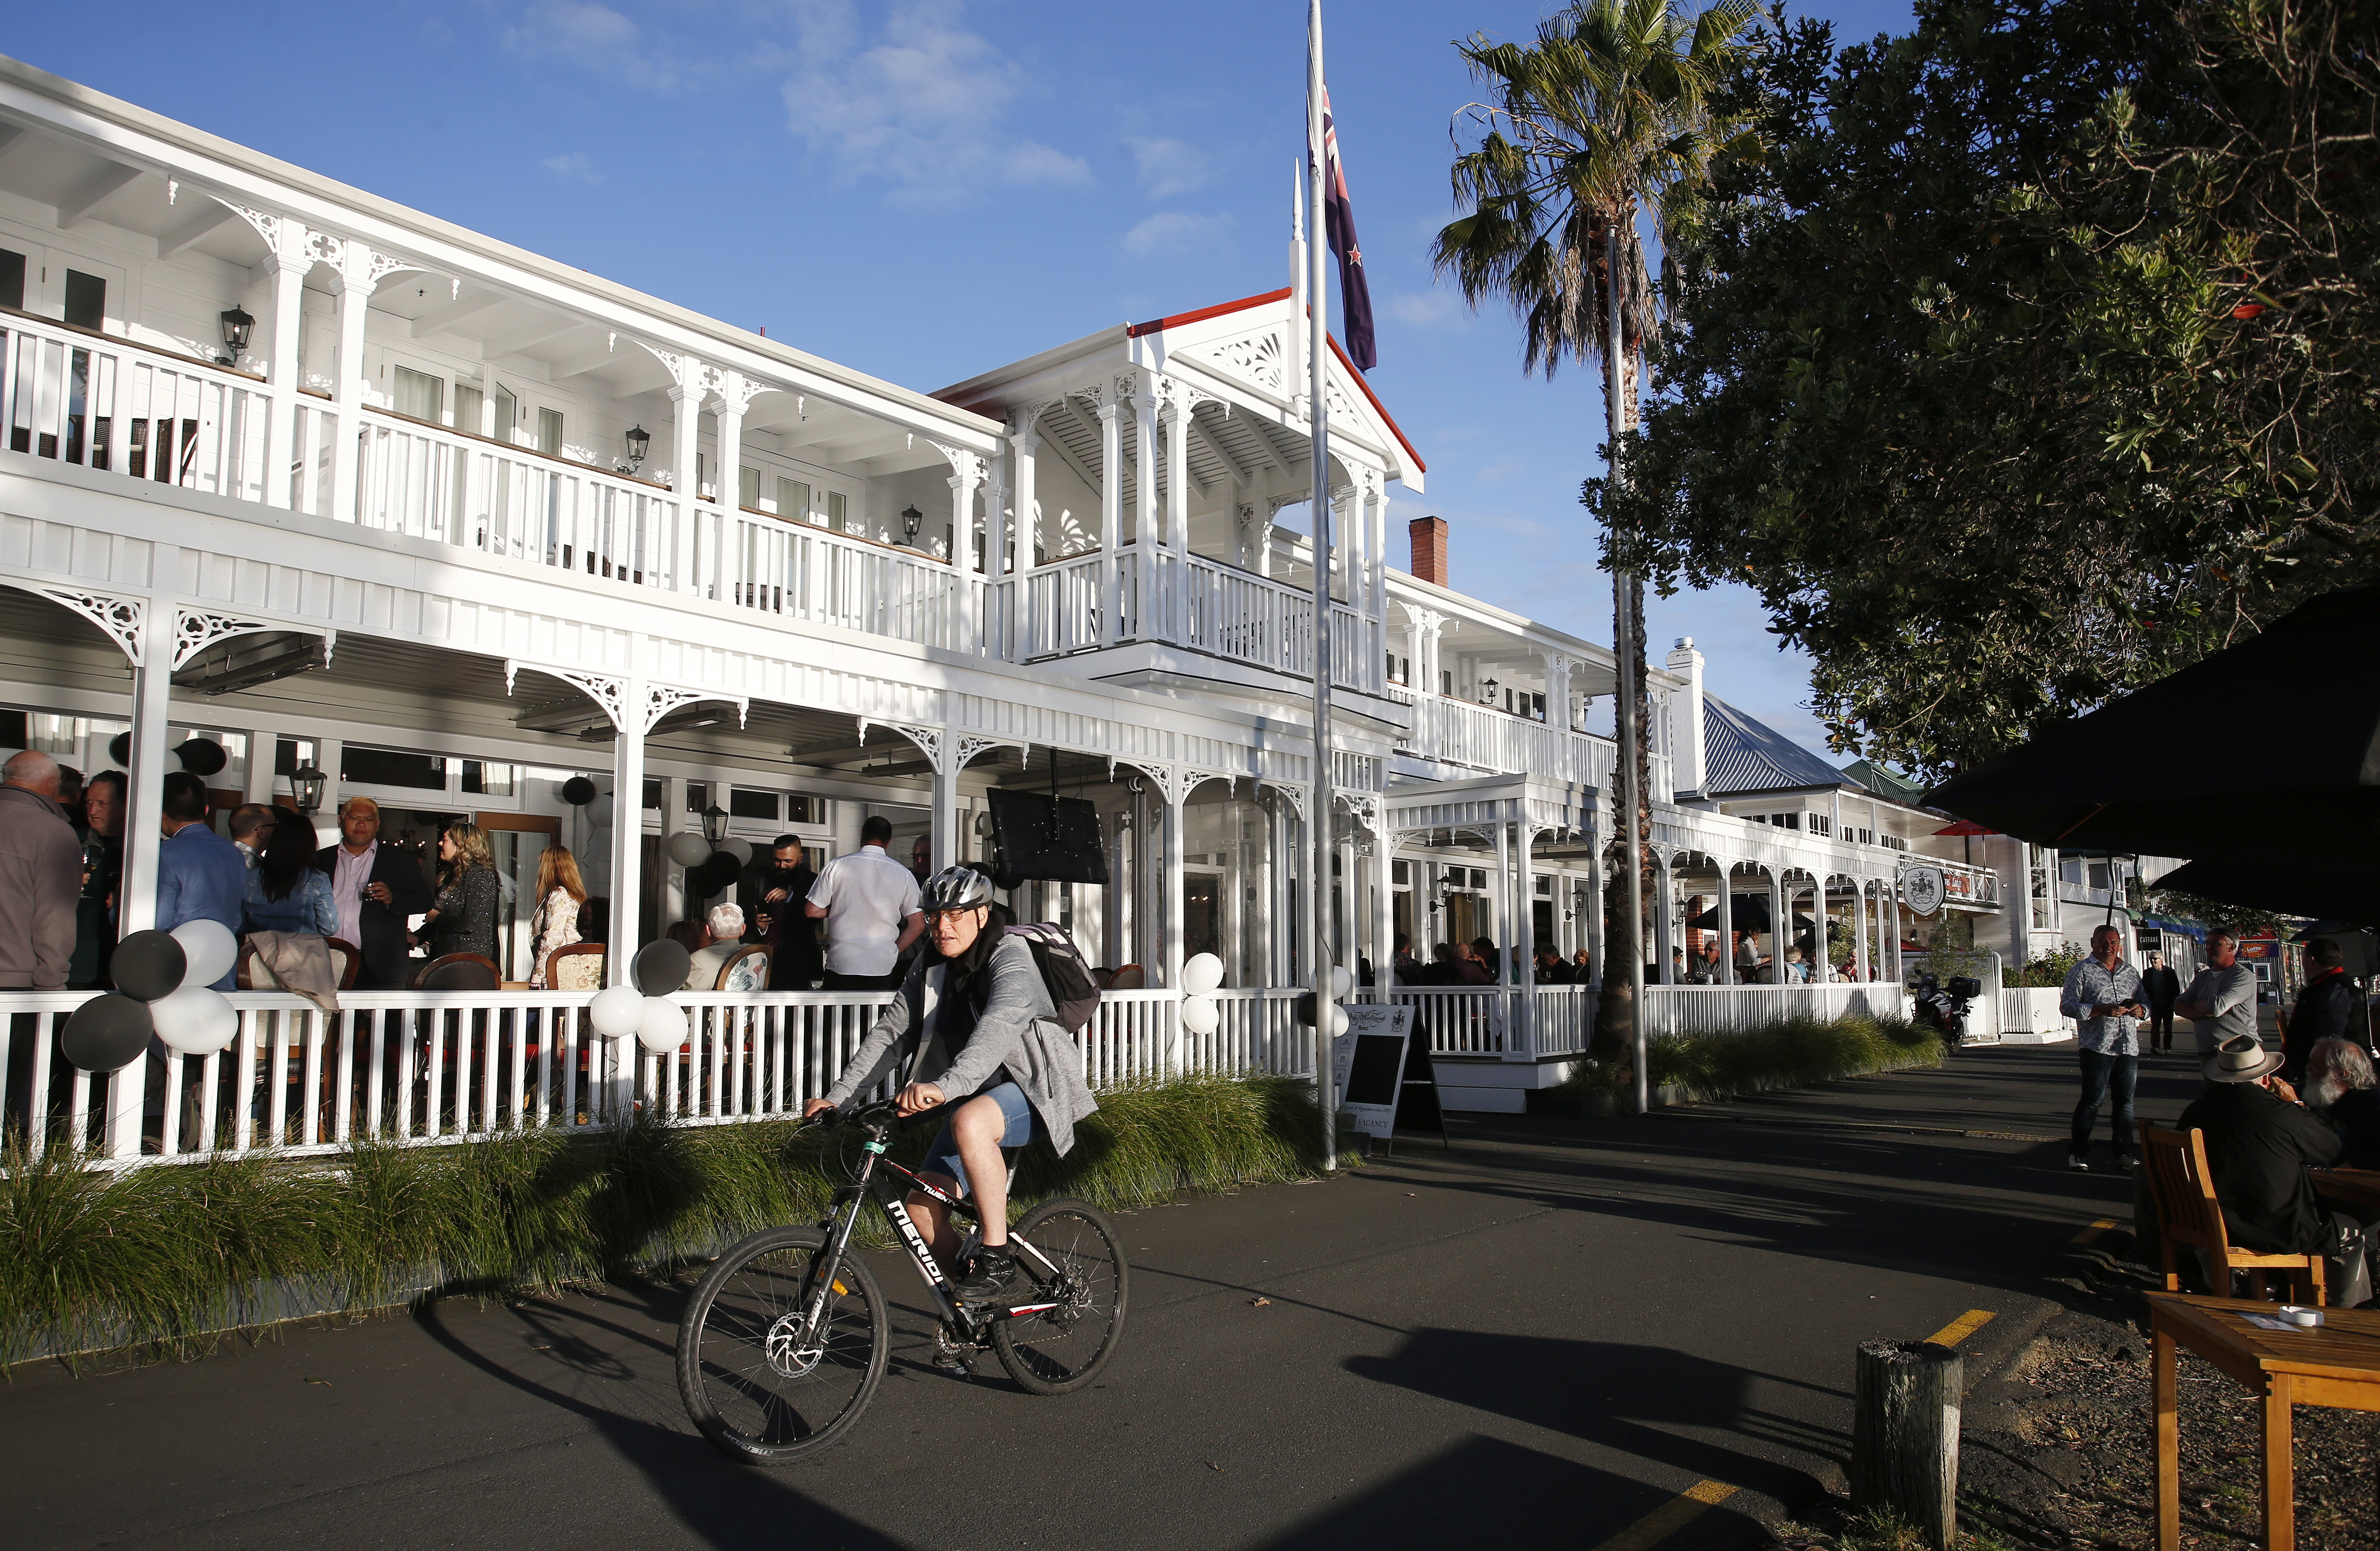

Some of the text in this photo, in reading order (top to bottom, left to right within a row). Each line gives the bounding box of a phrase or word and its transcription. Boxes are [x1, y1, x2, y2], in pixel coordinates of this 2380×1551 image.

[1358, 1119, 1389, 1128] VACANCY
[923, 1184, 959, 1207] TWENTY
[886, 1199, 950, 1292] MERIDA
